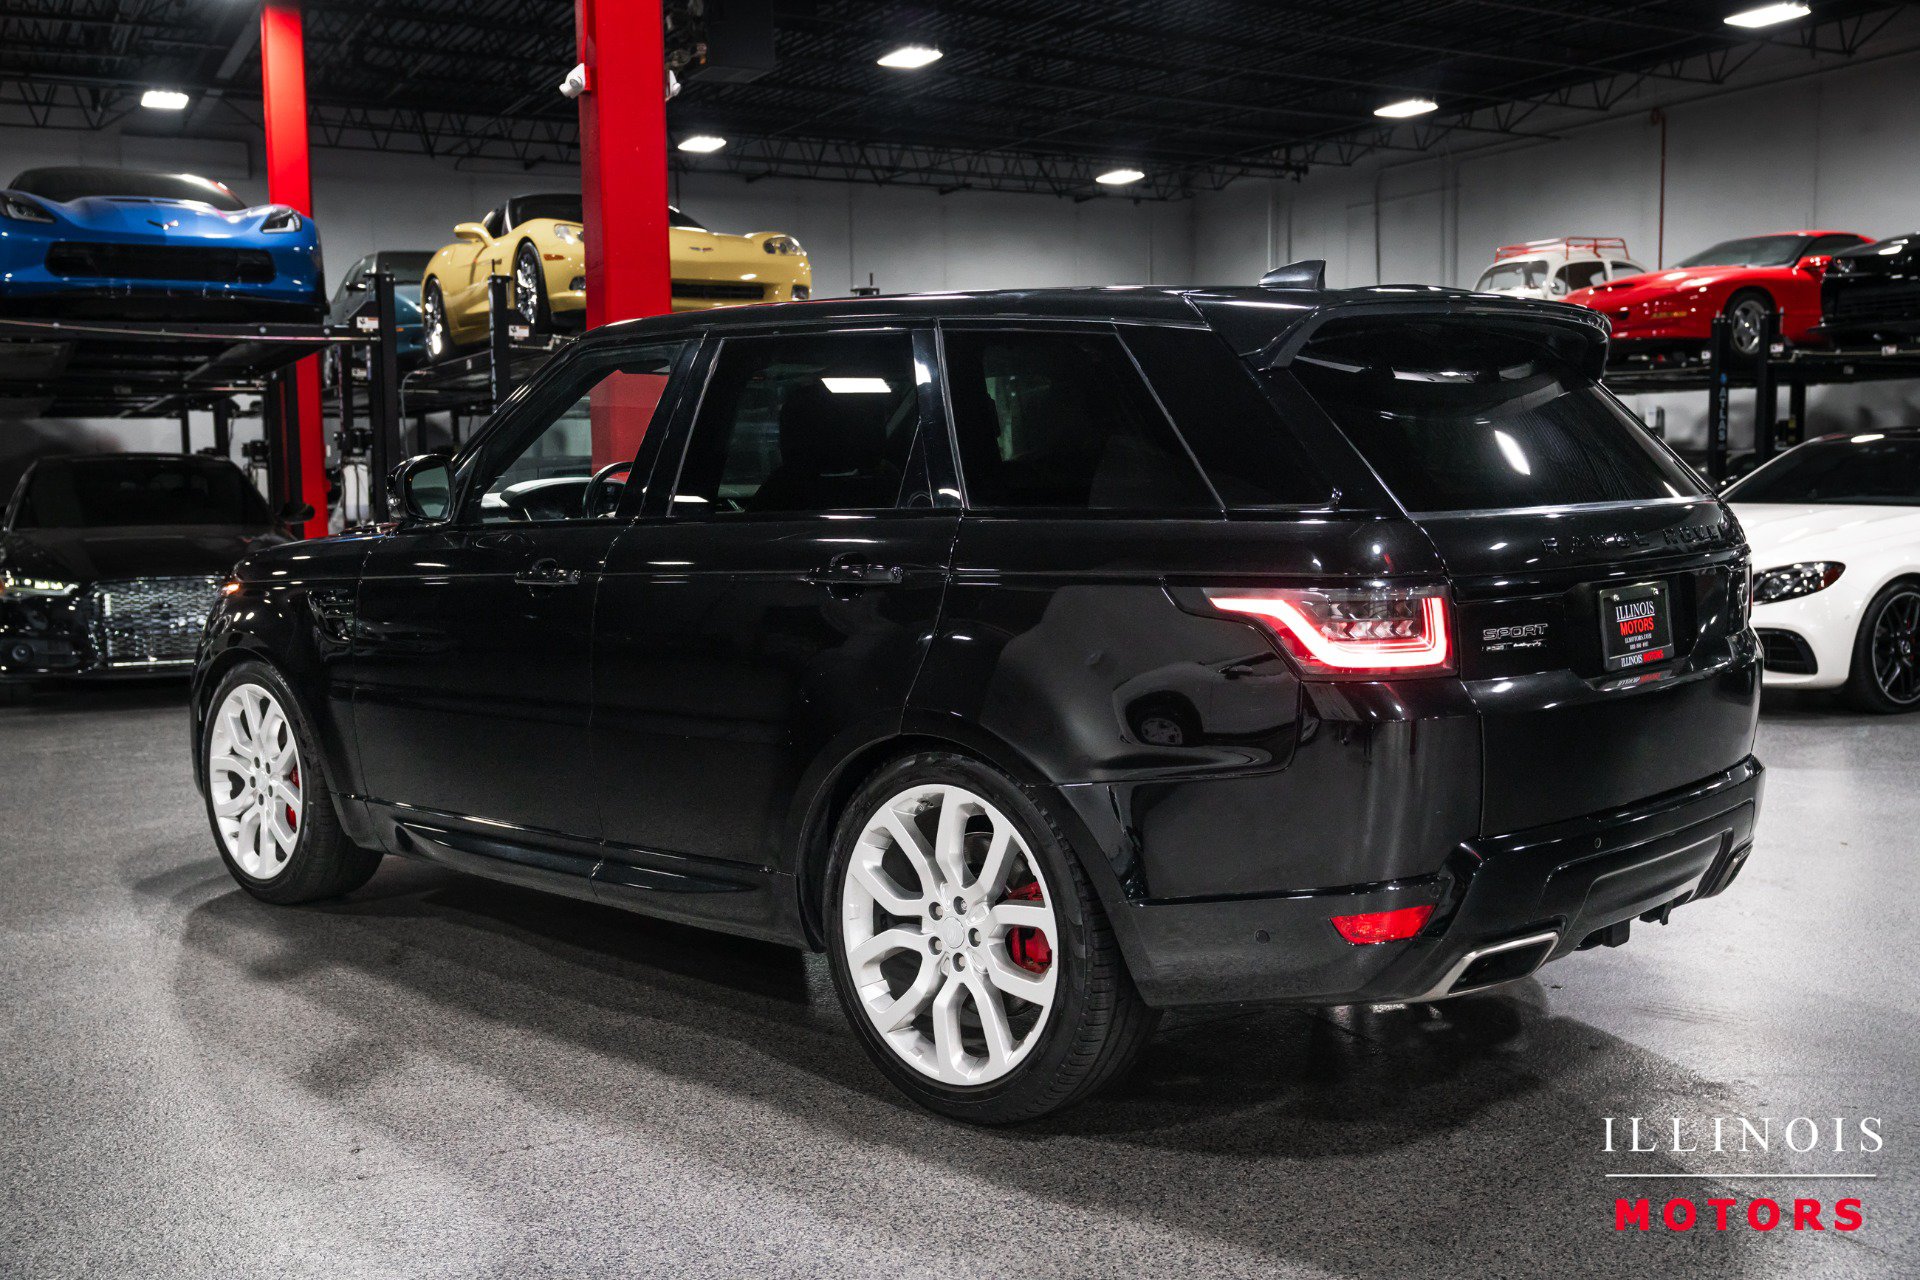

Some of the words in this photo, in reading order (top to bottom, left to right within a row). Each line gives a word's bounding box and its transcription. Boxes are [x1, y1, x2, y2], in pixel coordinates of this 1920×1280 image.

[1717, 386, 1727, 441] ATLAS
[1615, 601, 1655, 620] ILLINOIS
[1483, 623, 1548, 640] SPORT
[1620, 616, 1654, 636] MOTORS
[1621, 653, 1643, 668] ILLINOIS
